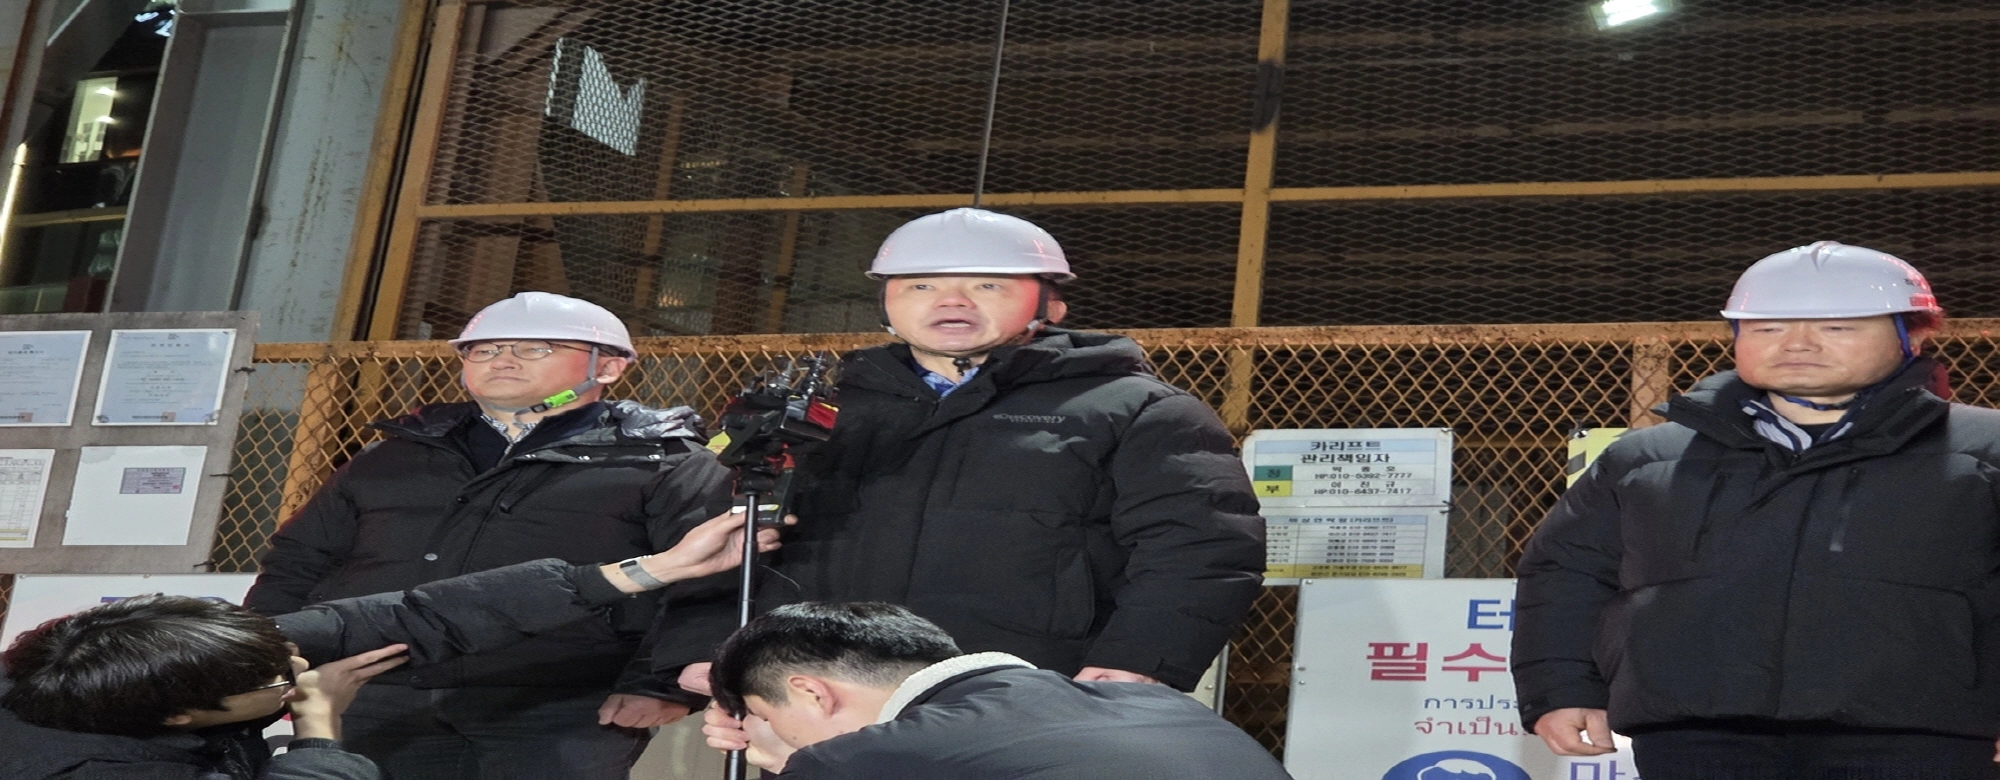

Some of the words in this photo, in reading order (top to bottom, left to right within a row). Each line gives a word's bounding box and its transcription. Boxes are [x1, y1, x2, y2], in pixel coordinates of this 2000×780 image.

[1310, 441, 1381, 451] 카리프트
[1300, 453, 1390, 464] 관리책임자
[1414, 716, 1527, 736] จำเป็น
